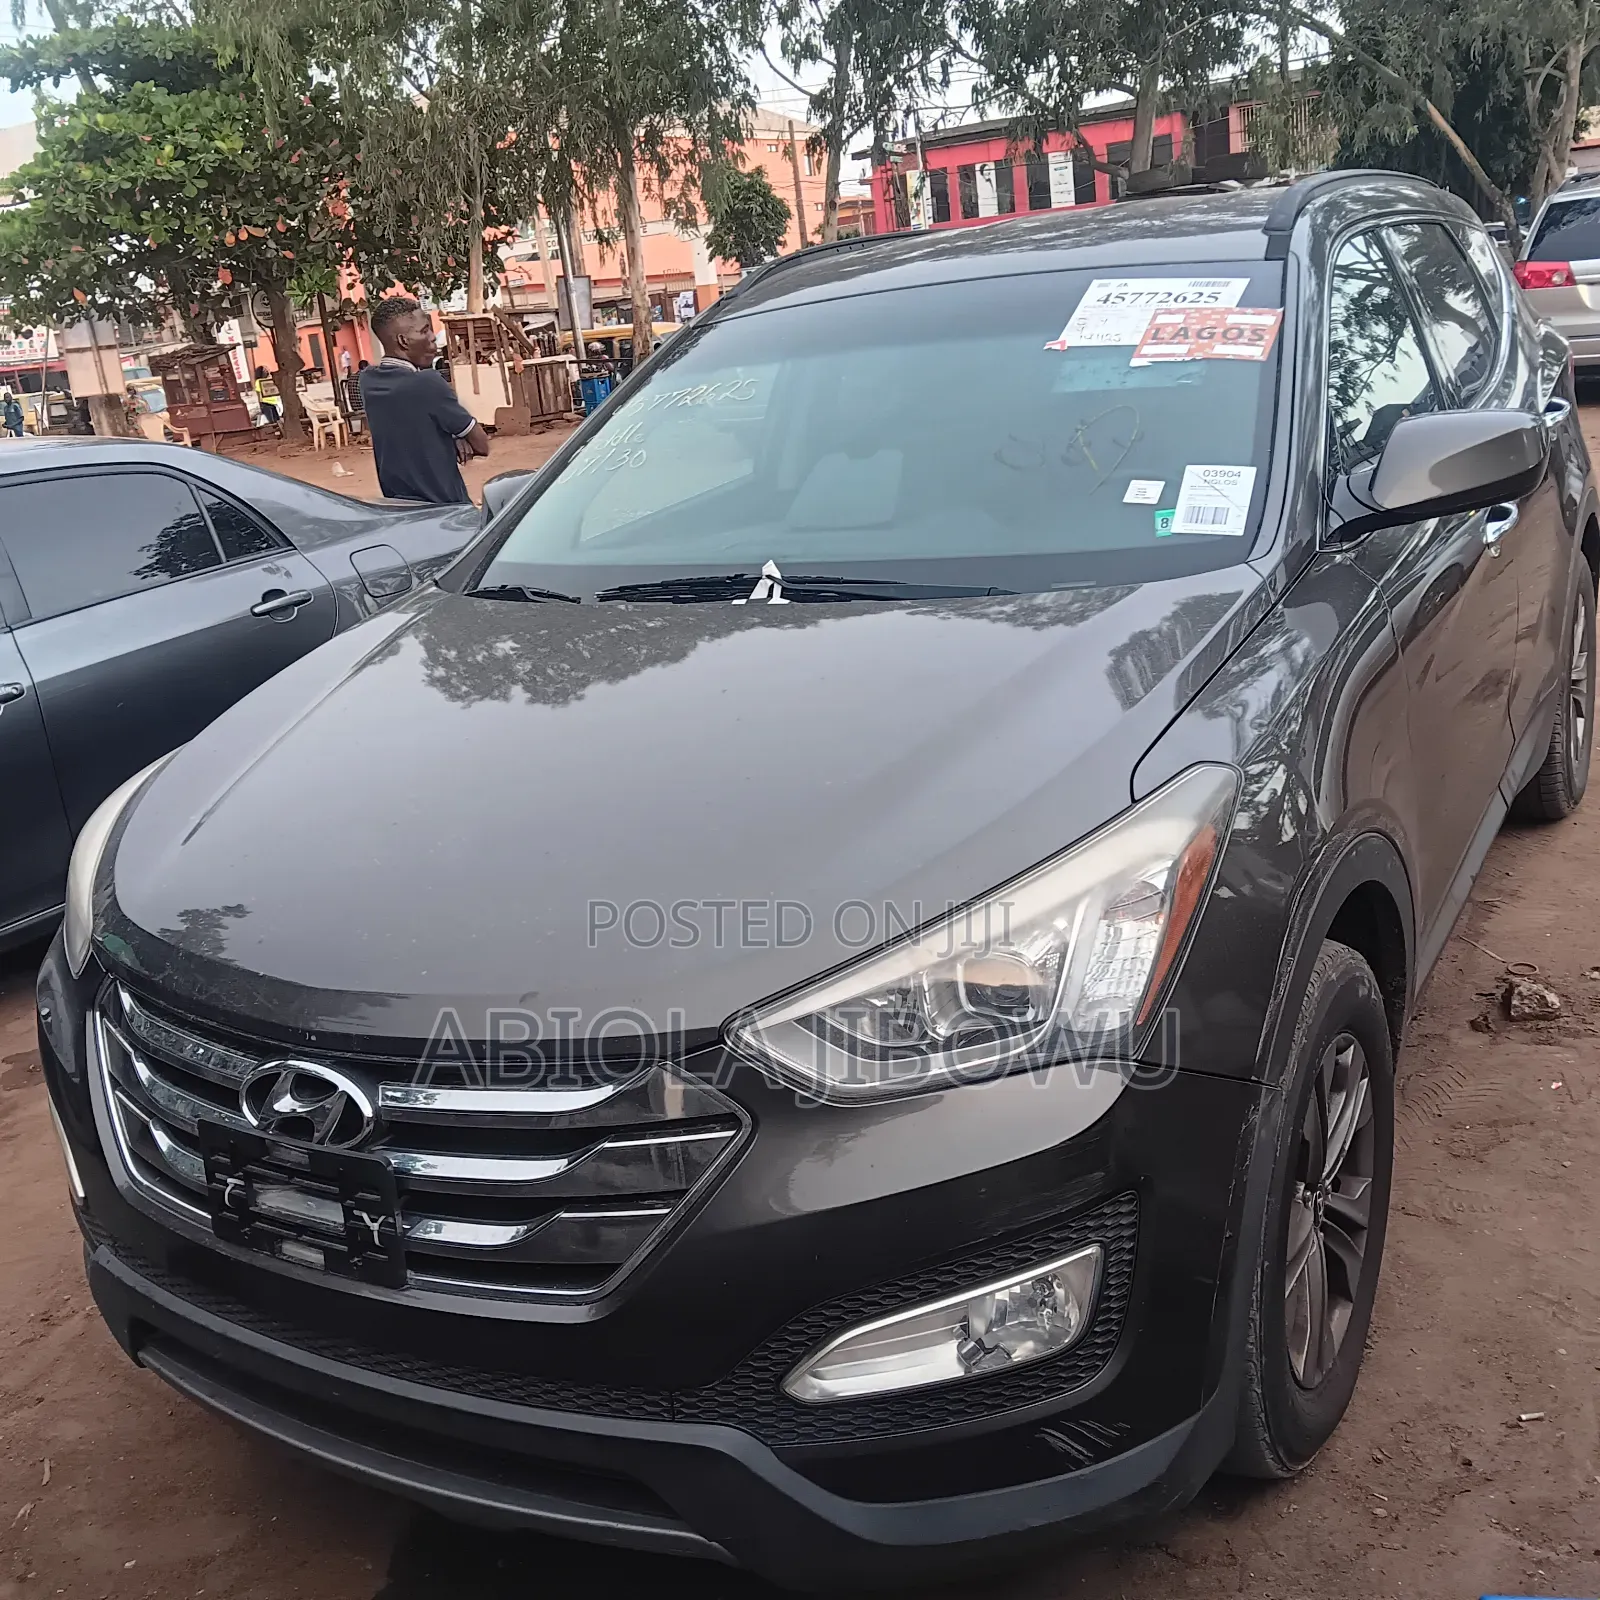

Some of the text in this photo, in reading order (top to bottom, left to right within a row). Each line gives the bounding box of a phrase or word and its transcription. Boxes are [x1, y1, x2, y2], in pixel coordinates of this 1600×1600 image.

[1096, 291, 1222, 304] 45772625
[1151, 326, 1268, 341] LAGOS
[1203, 469, 1241, 478] 03904
[1160, 517, 1169, 528] 8
